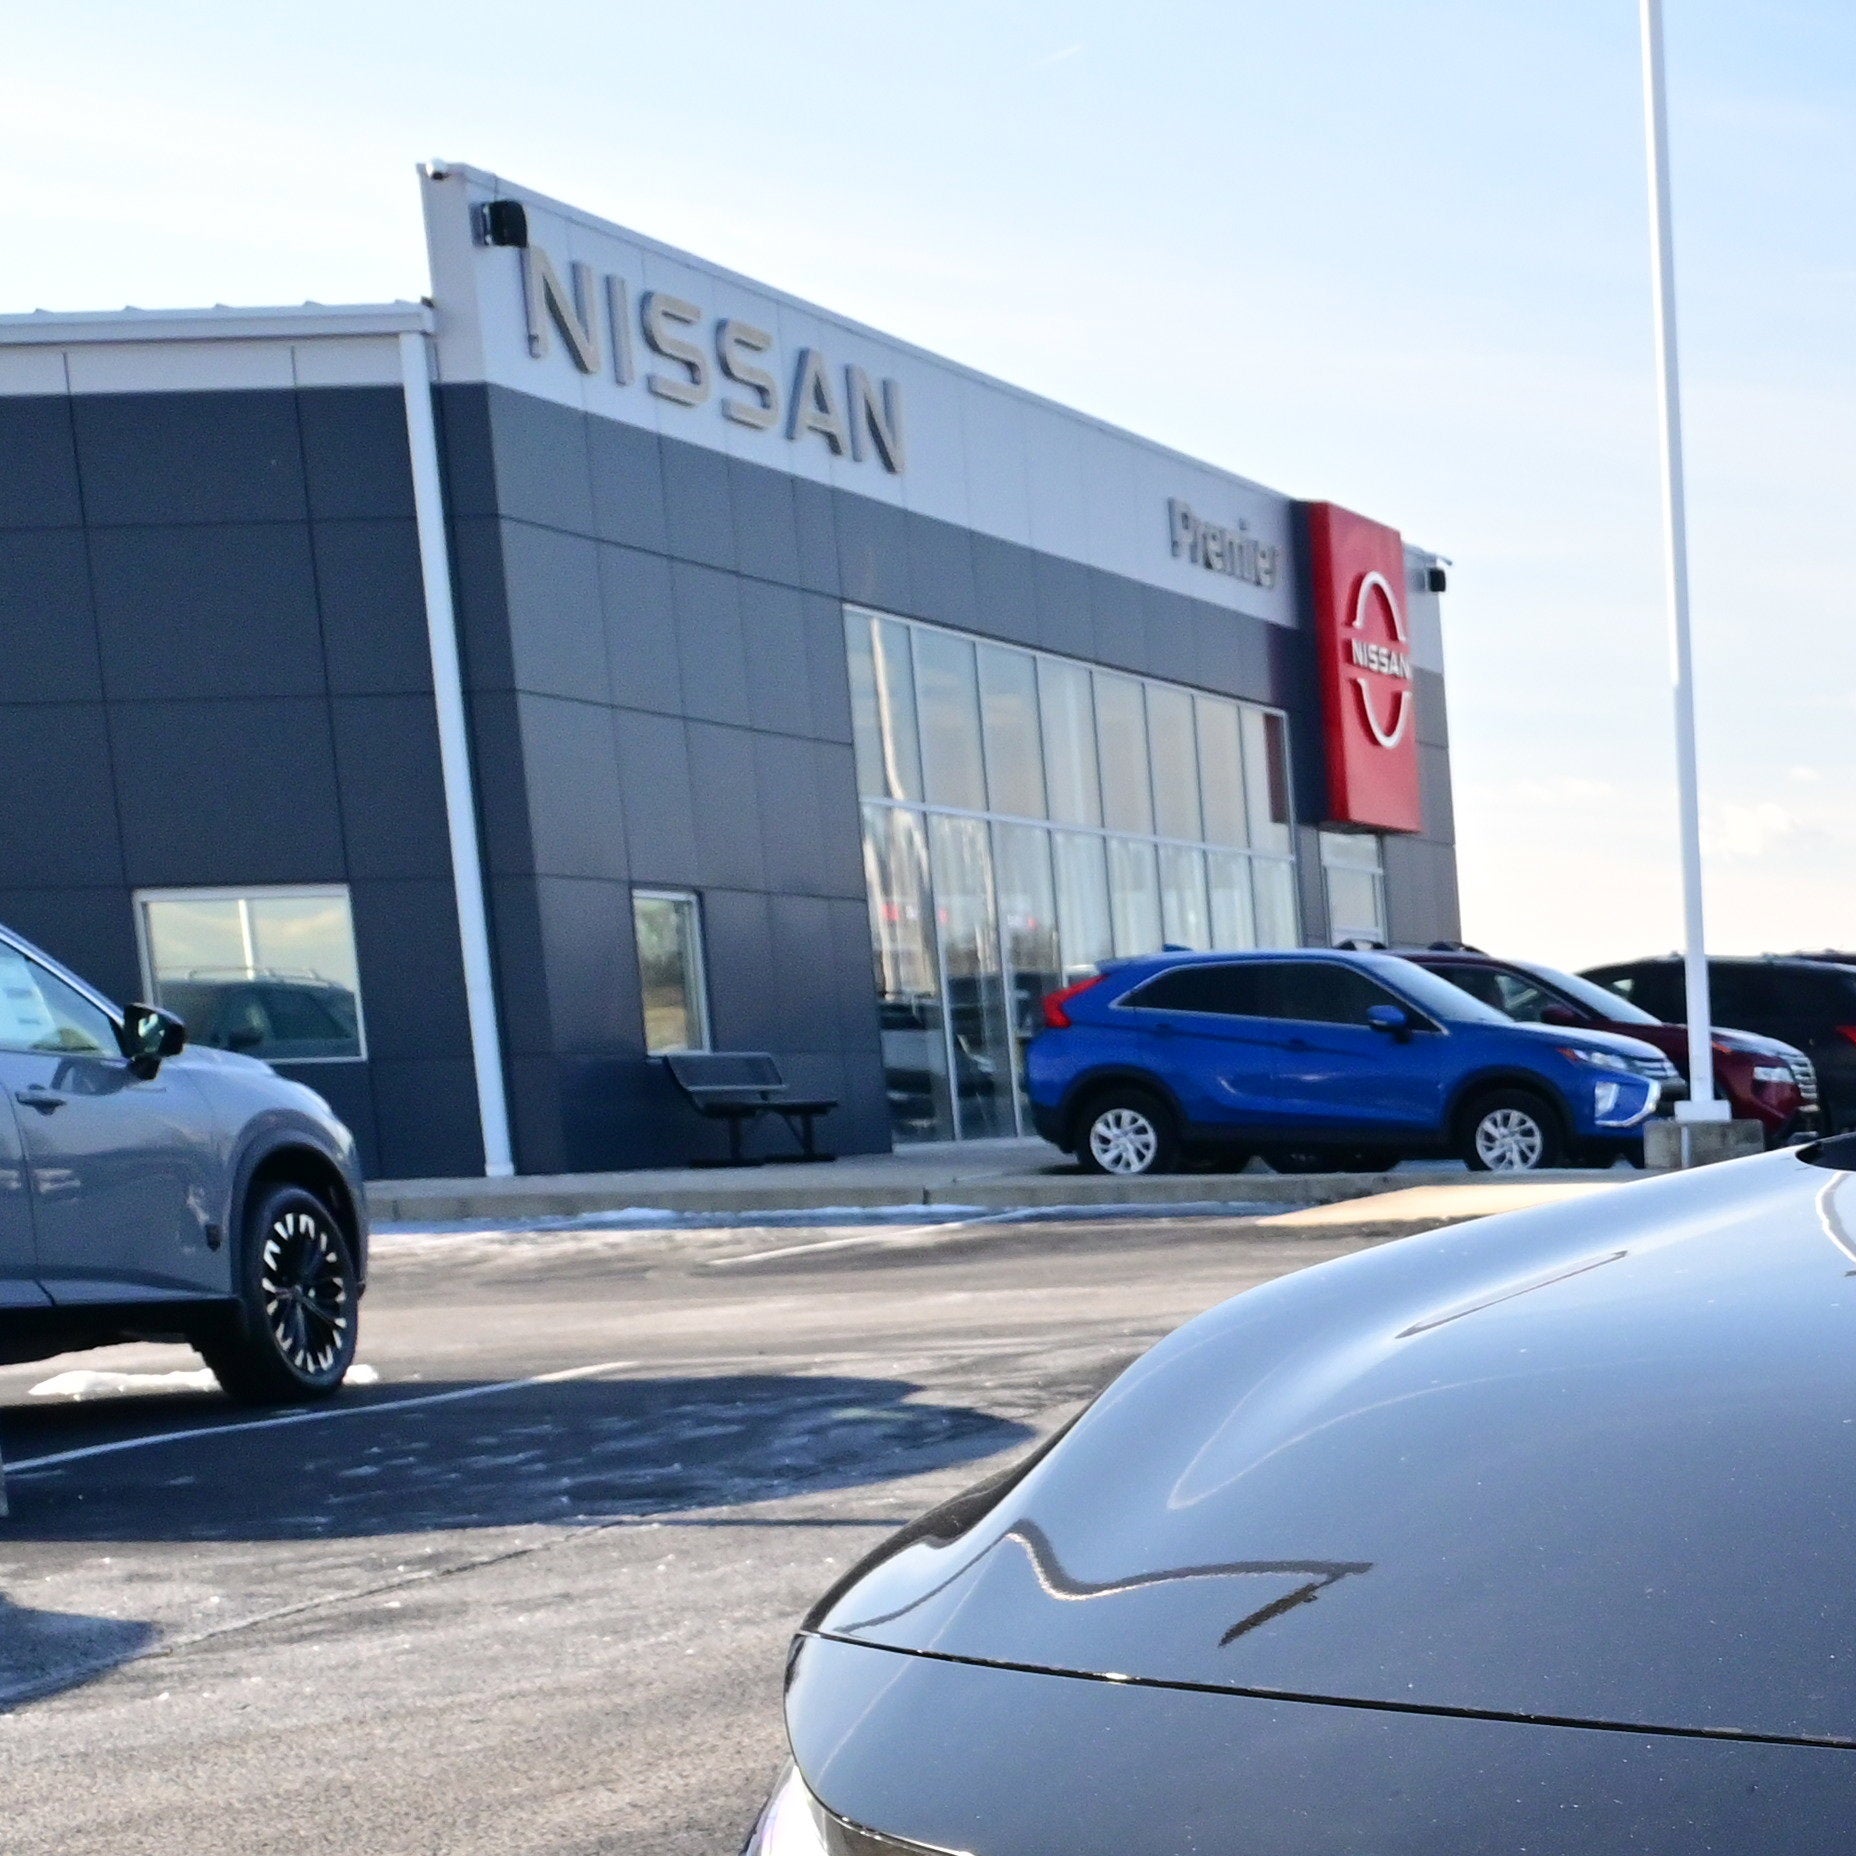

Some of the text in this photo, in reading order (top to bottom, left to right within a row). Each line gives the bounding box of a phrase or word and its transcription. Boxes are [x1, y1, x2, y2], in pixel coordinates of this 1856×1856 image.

[520, 246, 906, 475] NISSAN
[1167, 497, 1281, 588] Premier
[1351, 638, 1413, 680] NISSAN
